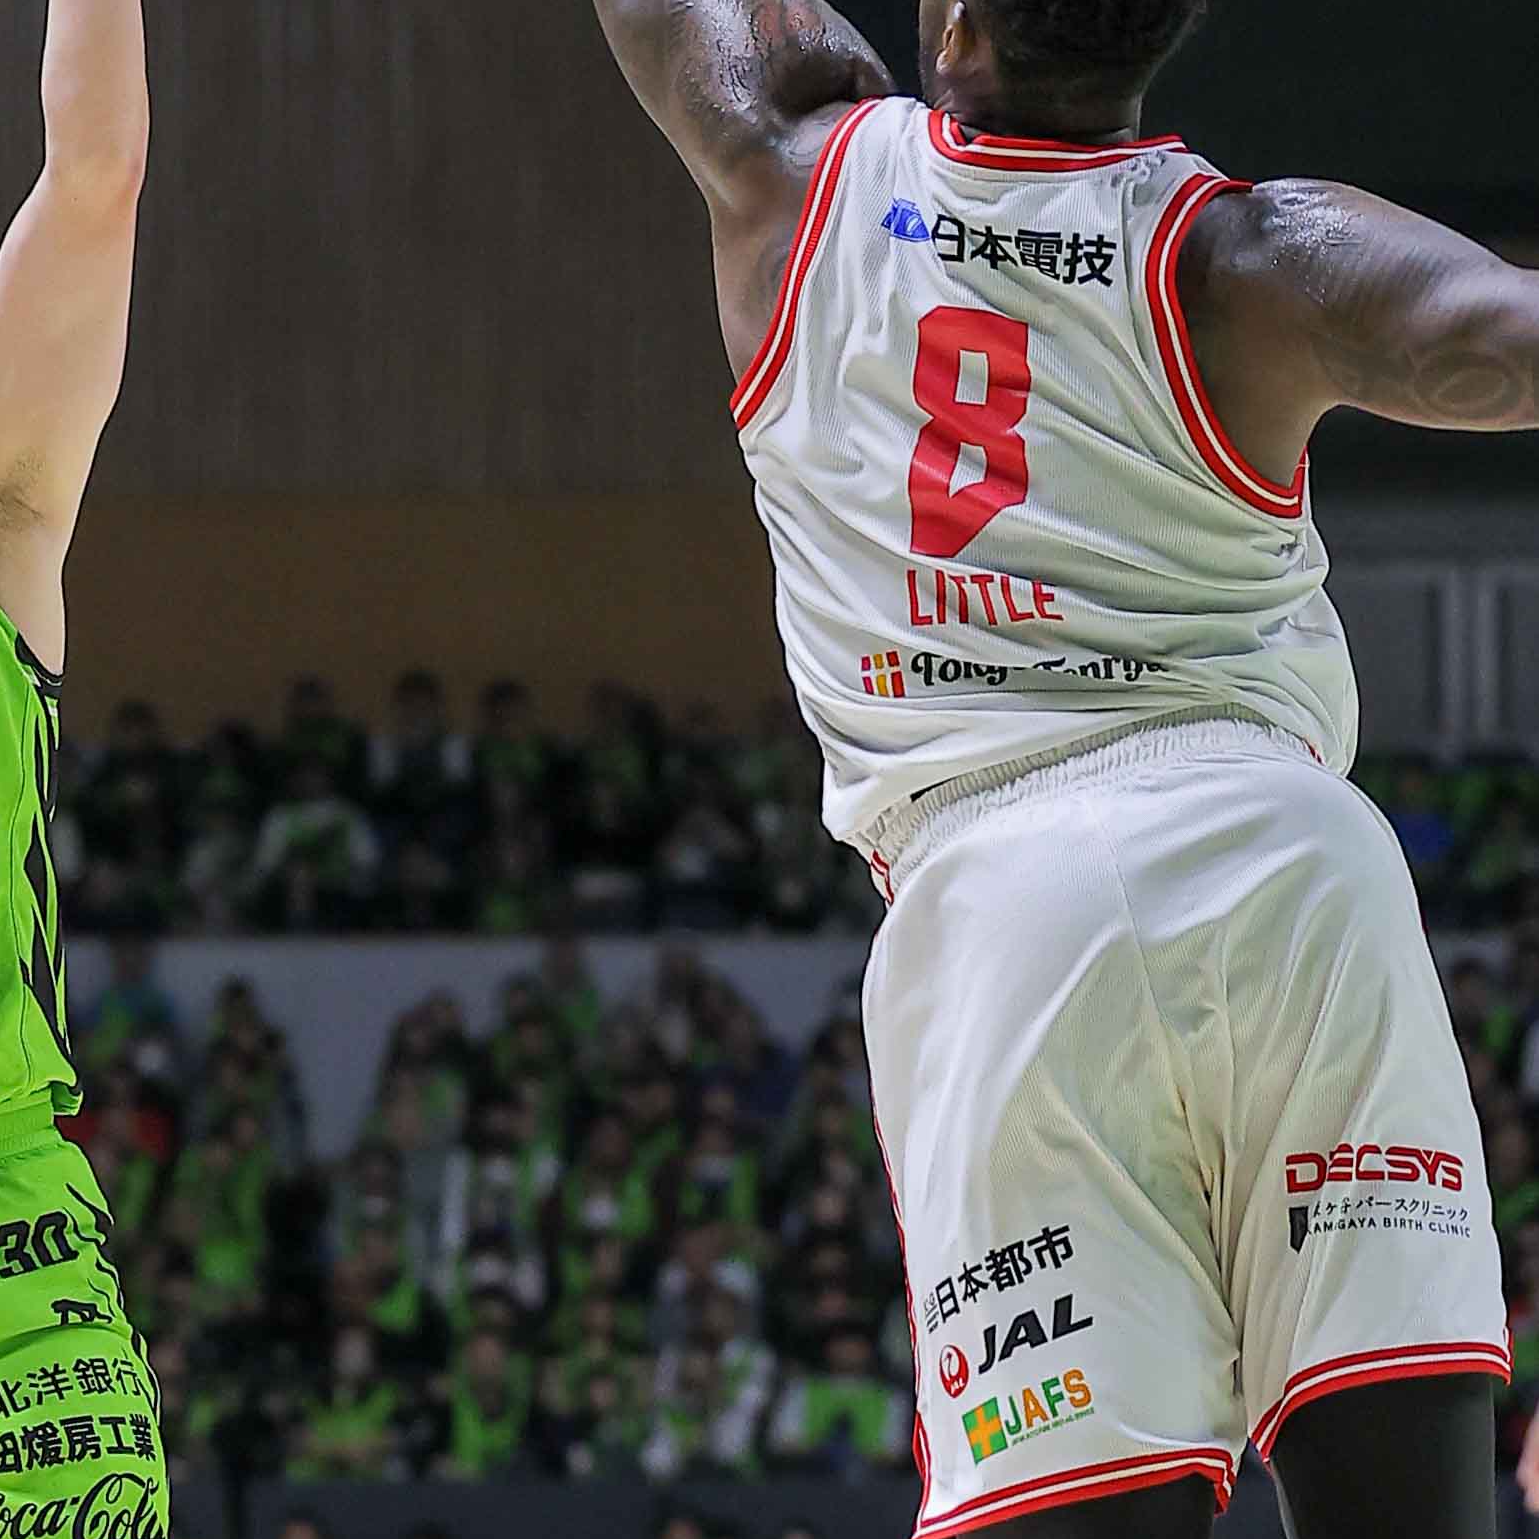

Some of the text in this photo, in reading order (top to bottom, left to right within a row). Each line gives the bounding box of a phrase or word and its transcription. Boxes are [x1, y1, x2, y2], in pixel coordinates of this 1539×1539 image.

[932, 213, 1117, 288] 日本電技
[908, 305, 1032, 558] 8
[907, 569, 1064, 626] LITTLE
[1286, 1143, 1463, 1193] DECSYS
[1307, 1216, 1471, 1239] AMIGAYA BIRTH CLINIC
[935, 1225, 1074, 1324] 日本都市
[978, 1293, 1094, 1375] JAL
[1005, 1368, 1093, 1435] JAFS
